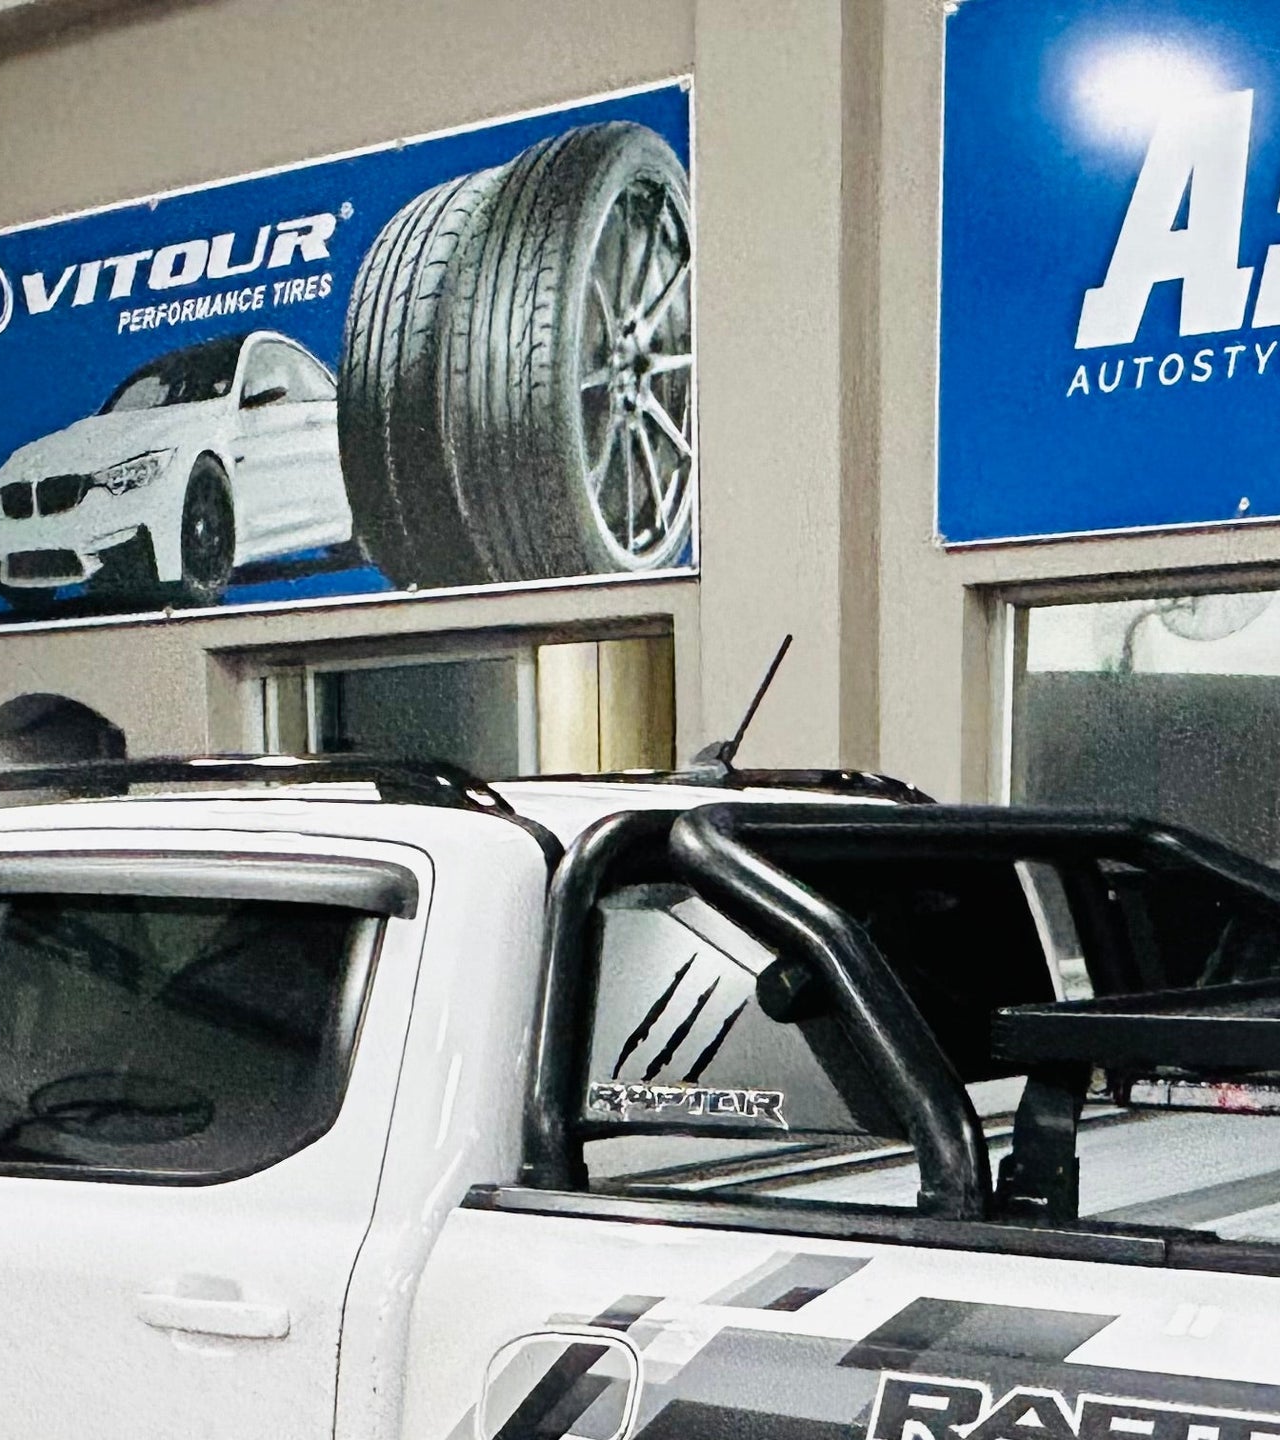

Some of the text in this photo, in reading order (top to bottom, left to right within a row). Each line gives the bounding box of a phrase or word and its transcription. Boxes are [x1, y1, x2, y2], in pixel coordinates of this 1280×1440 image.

[22, 213, 337, 316] VITOUR
[117, 273, 334, 335] PERFORMANCE TIRES
